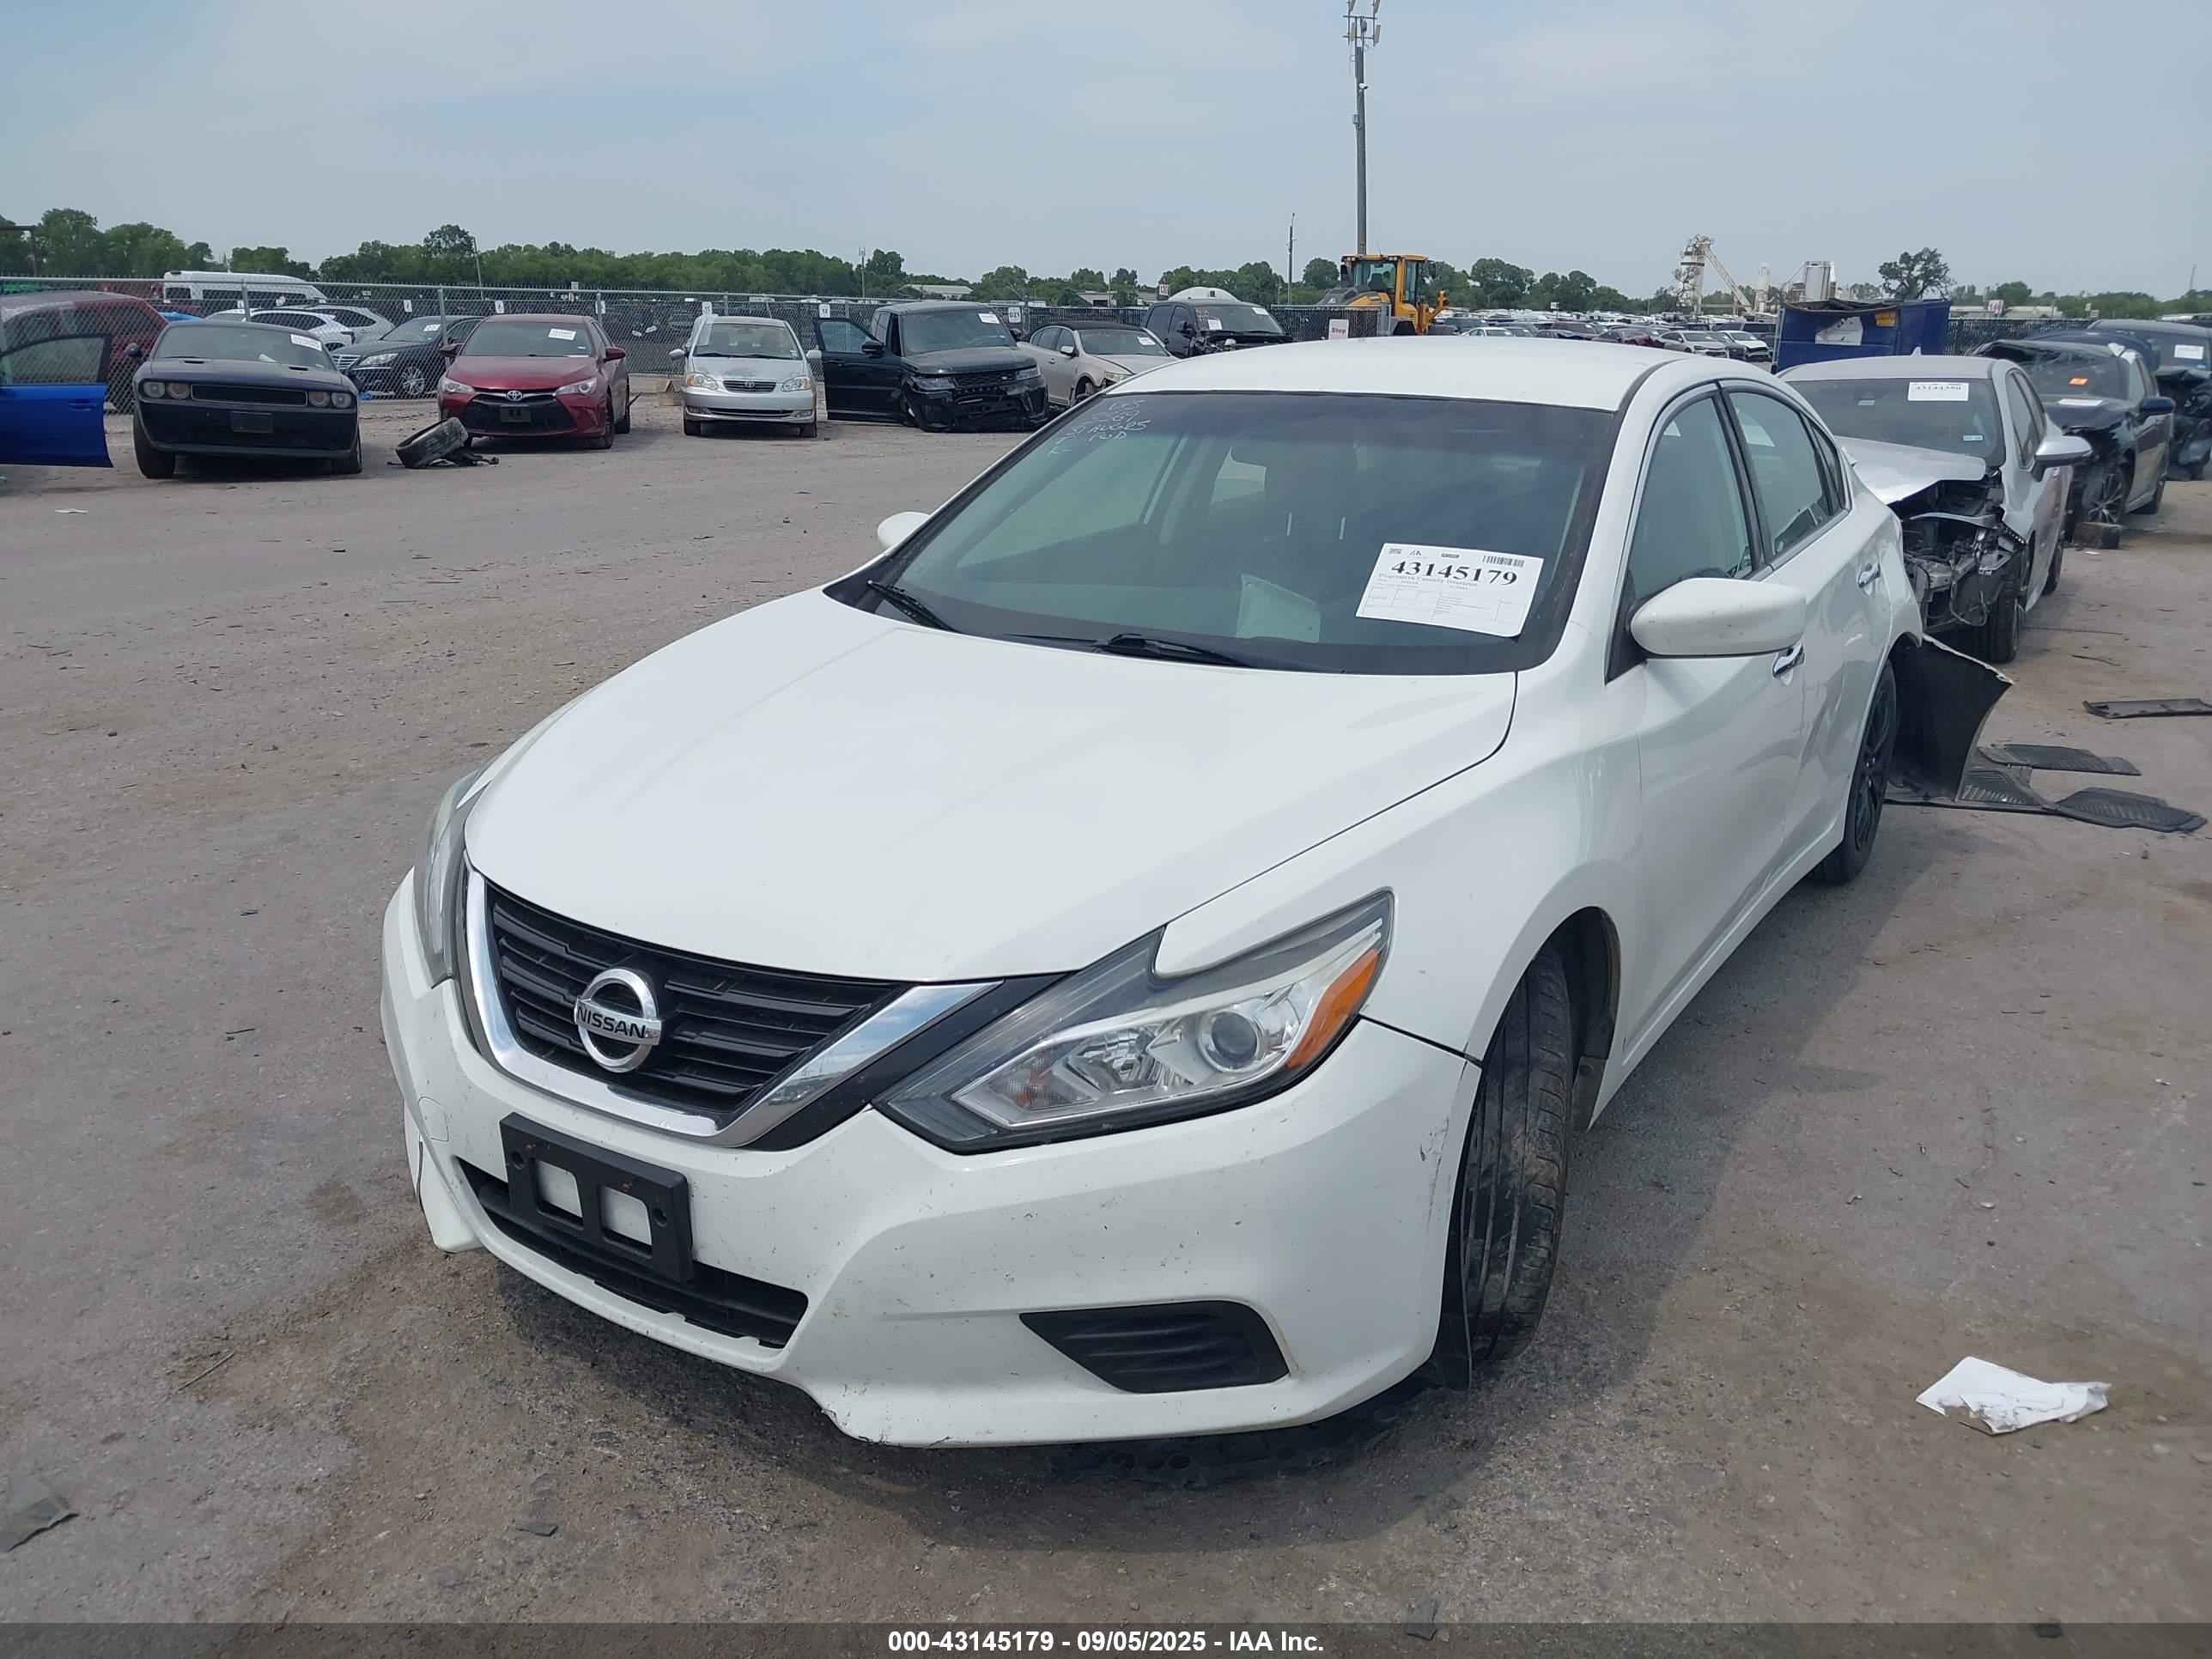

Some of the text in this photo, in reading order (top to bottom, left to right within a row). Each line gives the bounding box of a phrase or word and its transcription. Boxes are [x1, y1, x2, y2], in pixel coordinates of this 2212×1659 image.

[1331, 326, 1346, 335] Stop
[1390, 560, 1518, 586] 43145179
[577, 1006, 647, 1039] NISSAN
